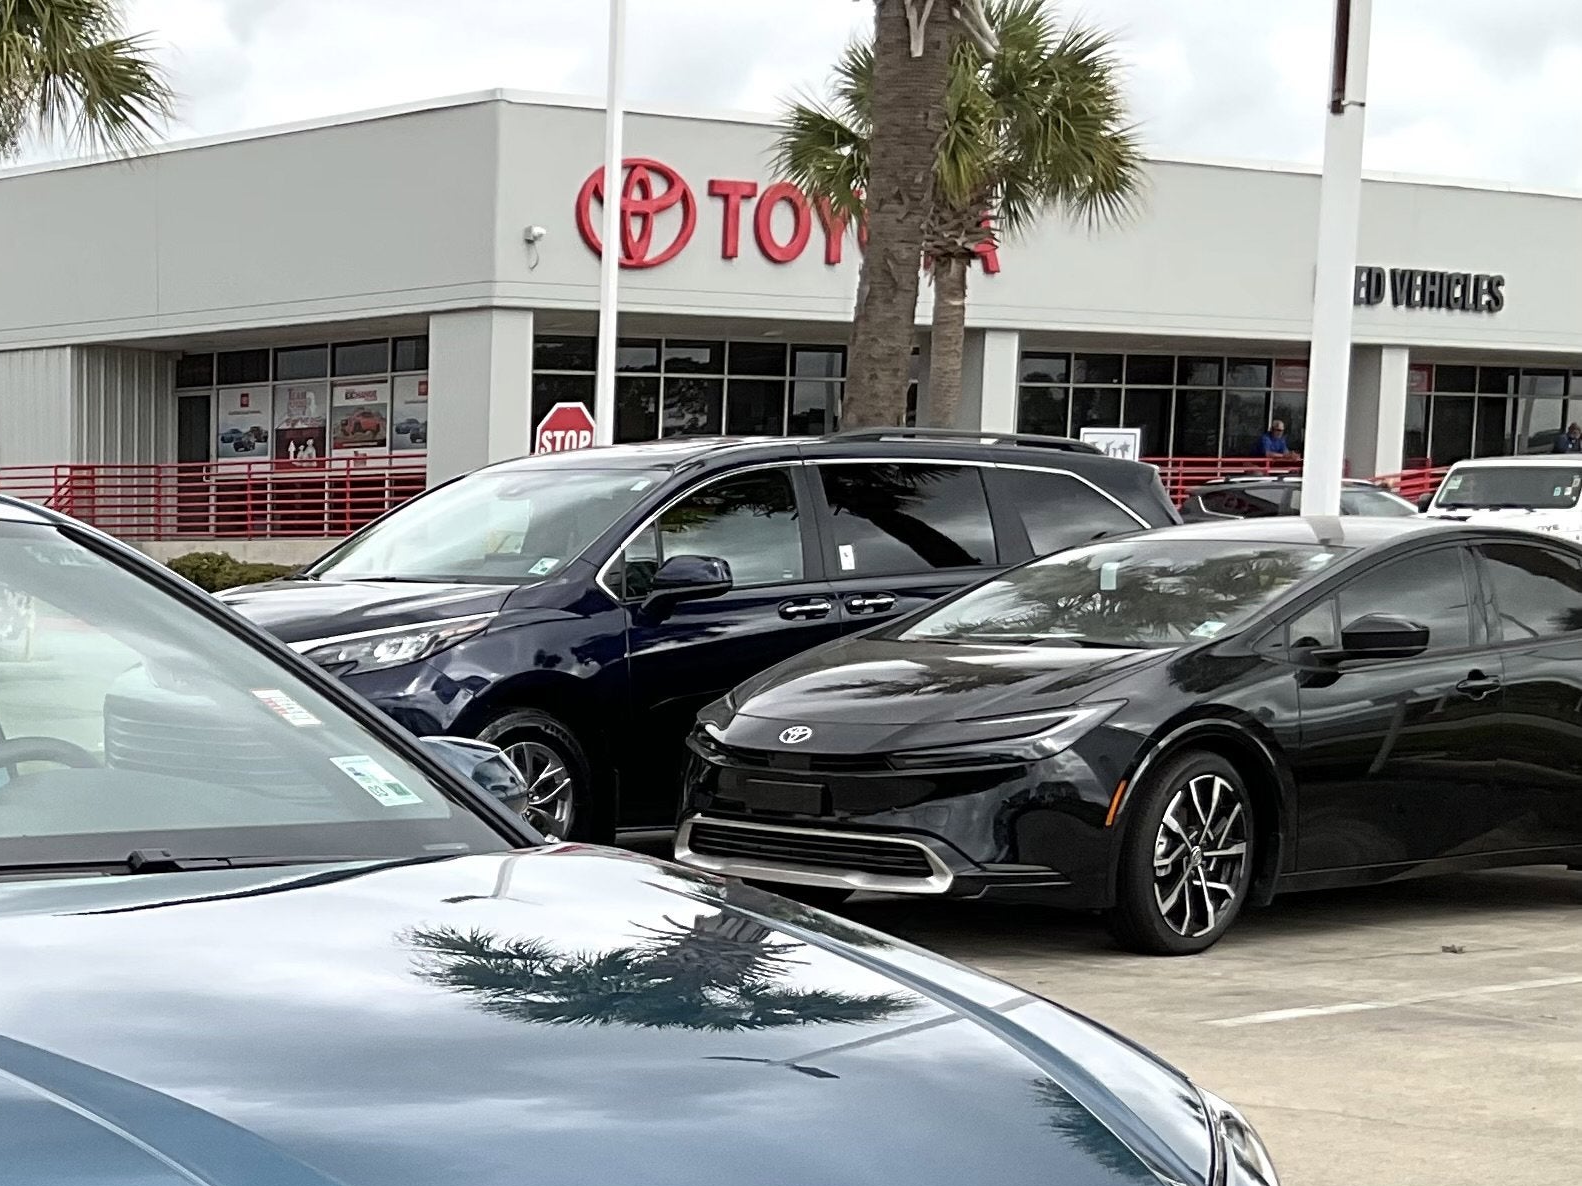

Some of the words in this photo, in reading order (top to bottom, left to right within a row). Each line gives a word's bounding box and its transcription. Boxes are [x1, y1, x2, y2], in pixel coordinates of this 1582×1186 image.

[708, 179, 1000, 275] TOY
[1354, 265, 1386, 306] ED
[1389, 268, 1506, 313] VEHICLES
[540, 429, 592, 453] STOP
